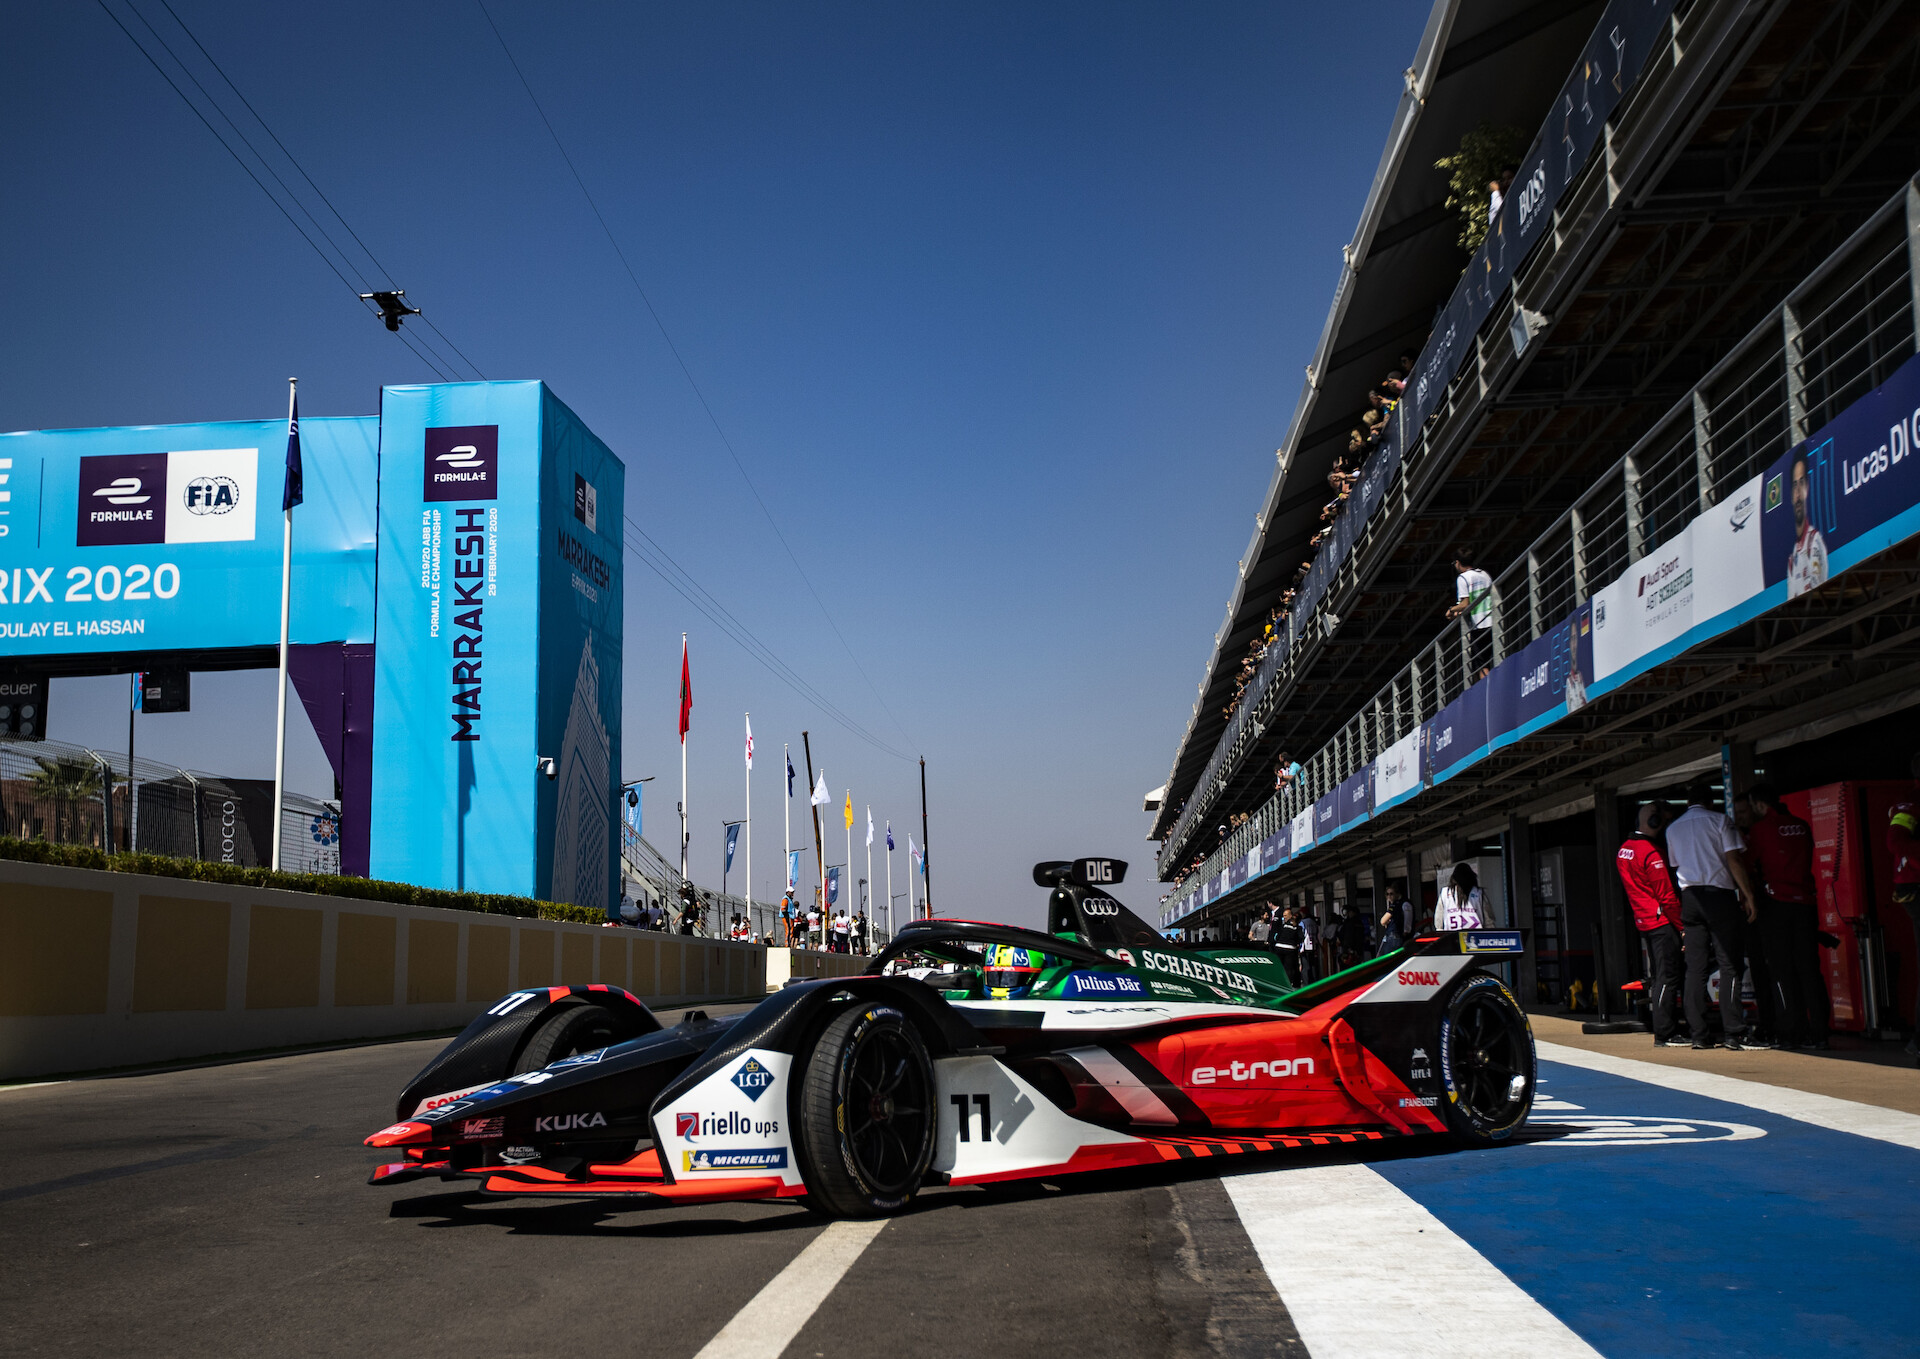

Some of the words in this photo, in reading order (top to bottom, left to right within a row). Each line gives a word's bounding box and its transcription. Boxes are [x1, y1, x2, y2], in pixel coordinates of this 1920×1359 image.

[1843, 444, 1889, 496] Lucas
[1890, 417, 1910, 465] DI
[423, 509, 432, 525] FIA
[489, 507, 498, 533] 2020
[422, 527, 431, 547] ABB
[432, 509, 442, 582] CHAMPIONSHIP
[421, 548, 431, 589] 2019/20
[488, 533, 497, 583] FEBRUARY
[558, 526, 610, 593] MARRAKESH
[1661, 556, 1680, 580] Sport
[65, 563, 181, 602] 2020
[488, 584, 497, 596] 29
[430, 590, 440, 638] FORMULA
[451, 508, 484, 741] MARRAKESH
[53, 621, 74, 636] EL
[77, 619, 145, 635] HASSAN
[0, 683, 37, 696] euer
[1086, 860, 1113, 882] DIG
[1477, 938, 1517, 947] MICHELIN
[1073, 975, 1116, 992] Julius
[1116, 977, 1141, 992] Bär
[1142, 949, 1259, 994] SCHAEFFLER
[1398, 970, 1440, 986] SONAX
[488, 992, 536, 1016] 11
[1441, 1022, 1452, 1082] MICHELIN
[738, 1072, 770, 1088] LGT
[1192, 1057, 1315, 1085] e-tron
[1404, 1097, 1438, 1107] FANBOOST
[535, 1111, 608, 1132] KUKA
[702, 1111, 751, 1136] riello
[755, 1121, 779, 1138] ups
[951, 1093, 991, 1142] 11
[712, 1153, 781, 1166] MICHELIN
